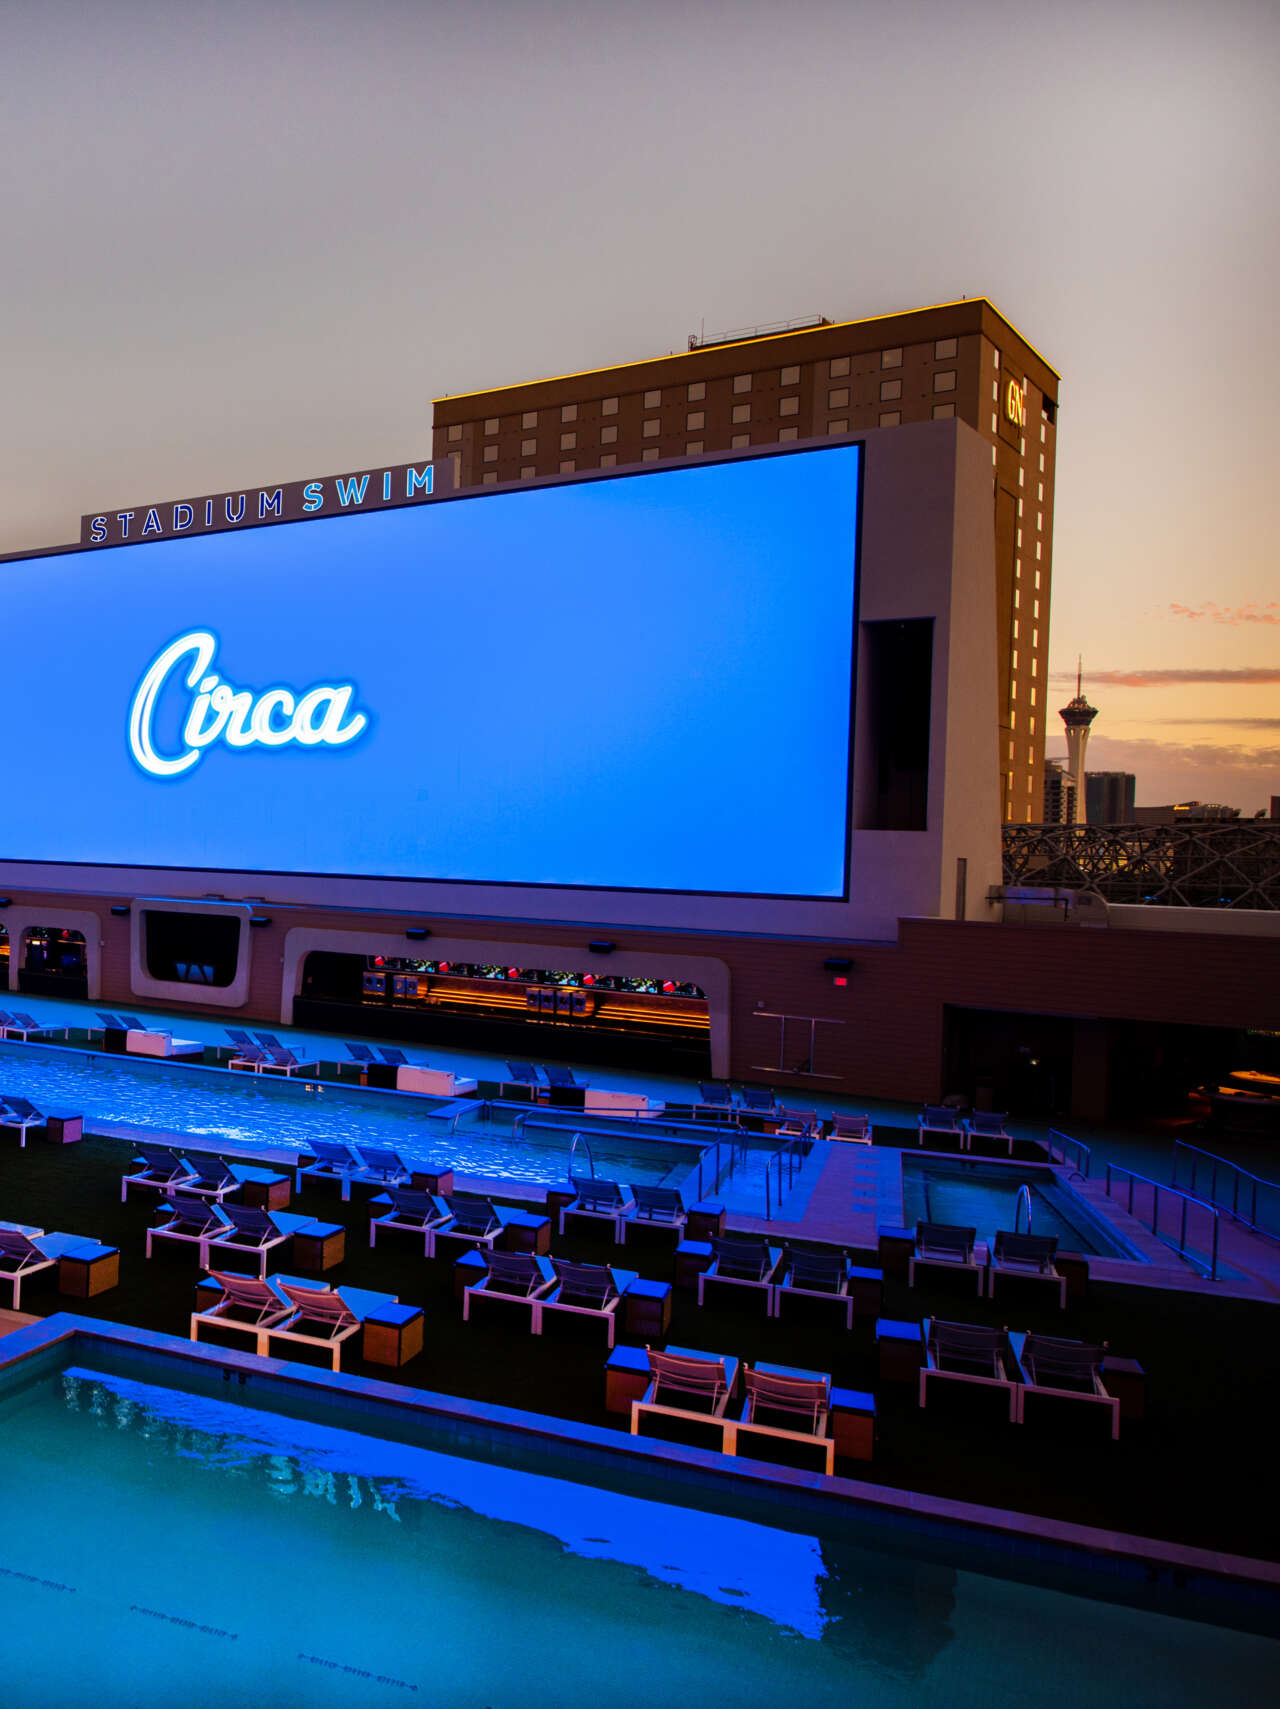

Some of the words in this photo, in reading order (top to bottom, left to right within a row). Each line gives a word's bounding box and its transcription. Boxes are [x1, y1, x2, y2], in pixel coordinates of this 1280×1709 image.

[1008, 379, 1024, 427] GN
[90, 489, 282, 542] STADIUM
[303, 465, 434, 512] SWIM
[130, 633, 367, 775] Circa
